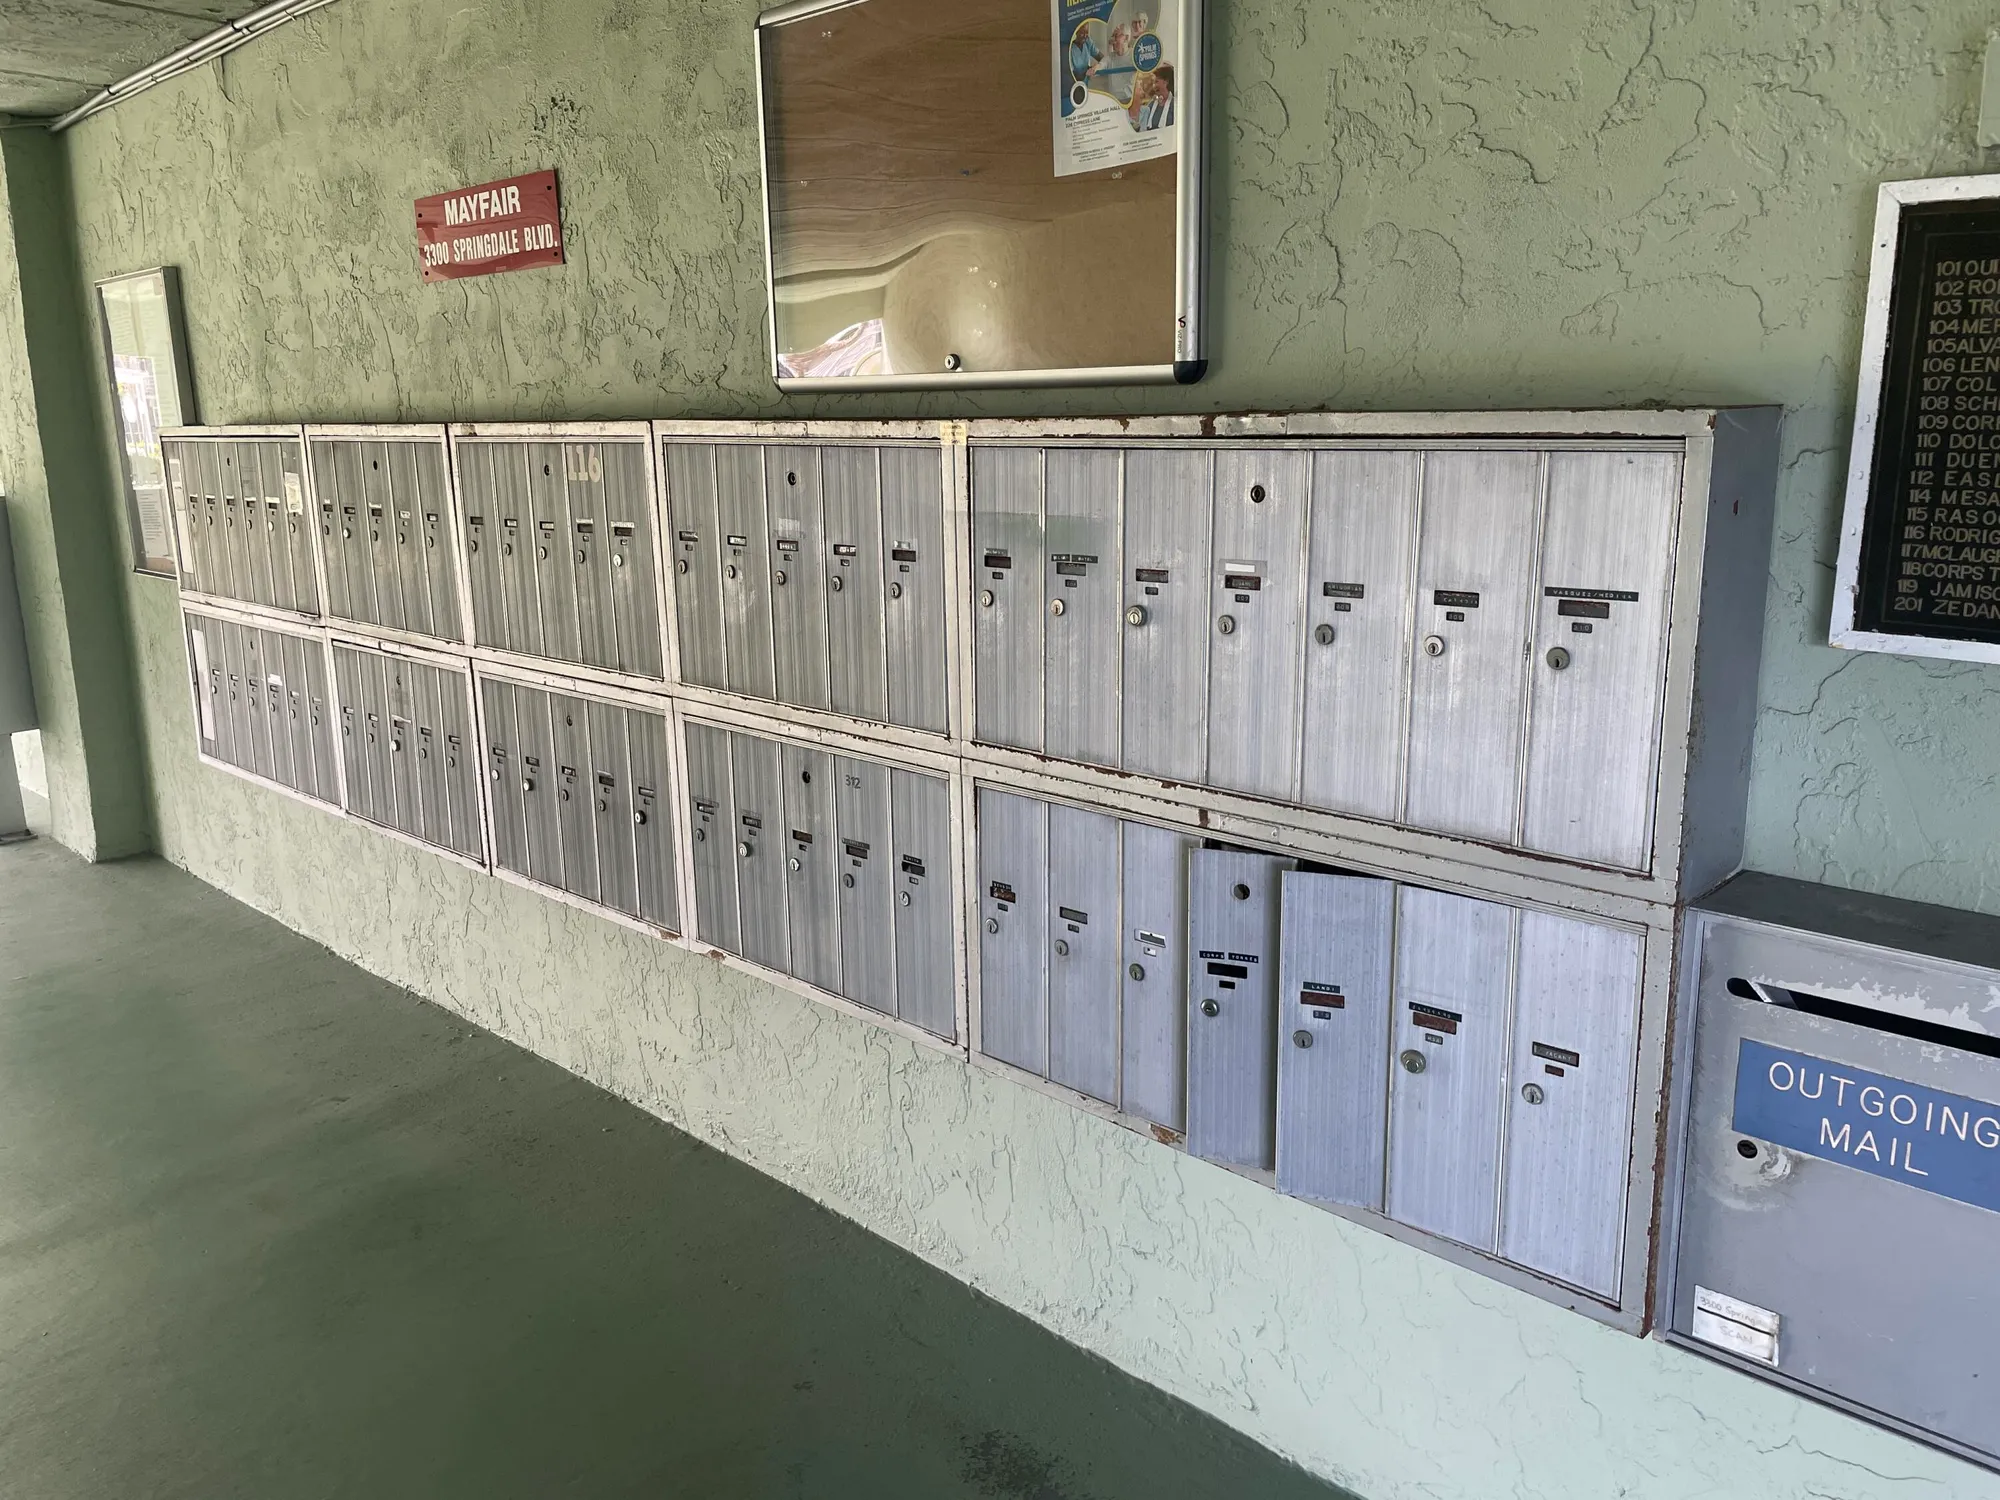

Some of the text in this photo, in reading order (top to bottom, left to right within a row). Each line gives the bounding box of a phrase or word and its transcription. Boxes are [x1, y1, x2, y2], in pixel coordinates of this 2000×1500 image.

[443, 185, 521, 226] MAYFAIR
[424, 223, 558, 267] 3300 SPRINGDALE BLVD.
[1937, 261, 1961, 276] 101
[1935, 281, 1964, 296] 102
[1933, 299, 1962, 315] 103
[1929, 319, 1960, 334] 104
[1928, 338, 1957, 354] 105
[1923, 357, 1956, 373] 106
[1923, 376, 1997, 392] 107 COL
[1920, 396, 2000, 411] 108 SCH
[1919, 415, 1948, 430] 109
[1917, 433, 1941, 448] 110
[1915, 452, 1934, 467] 111
[1910, 470, 1934, 484] 112
[1909, 489, 2000, 507] 114 MESA
[1907, 507, 2000, 526] 115 RASO
[1904, 525, 1925, 539] 116
[1922, 562, 1984, 581] CORPS
[1897, 579, 1918, 593] 119
[1894, 596, 1923, 612] 201
[1769, 1061, 2000, 1148] OUTGOING
[1820, 1117, 1929, 1176] MAIL
